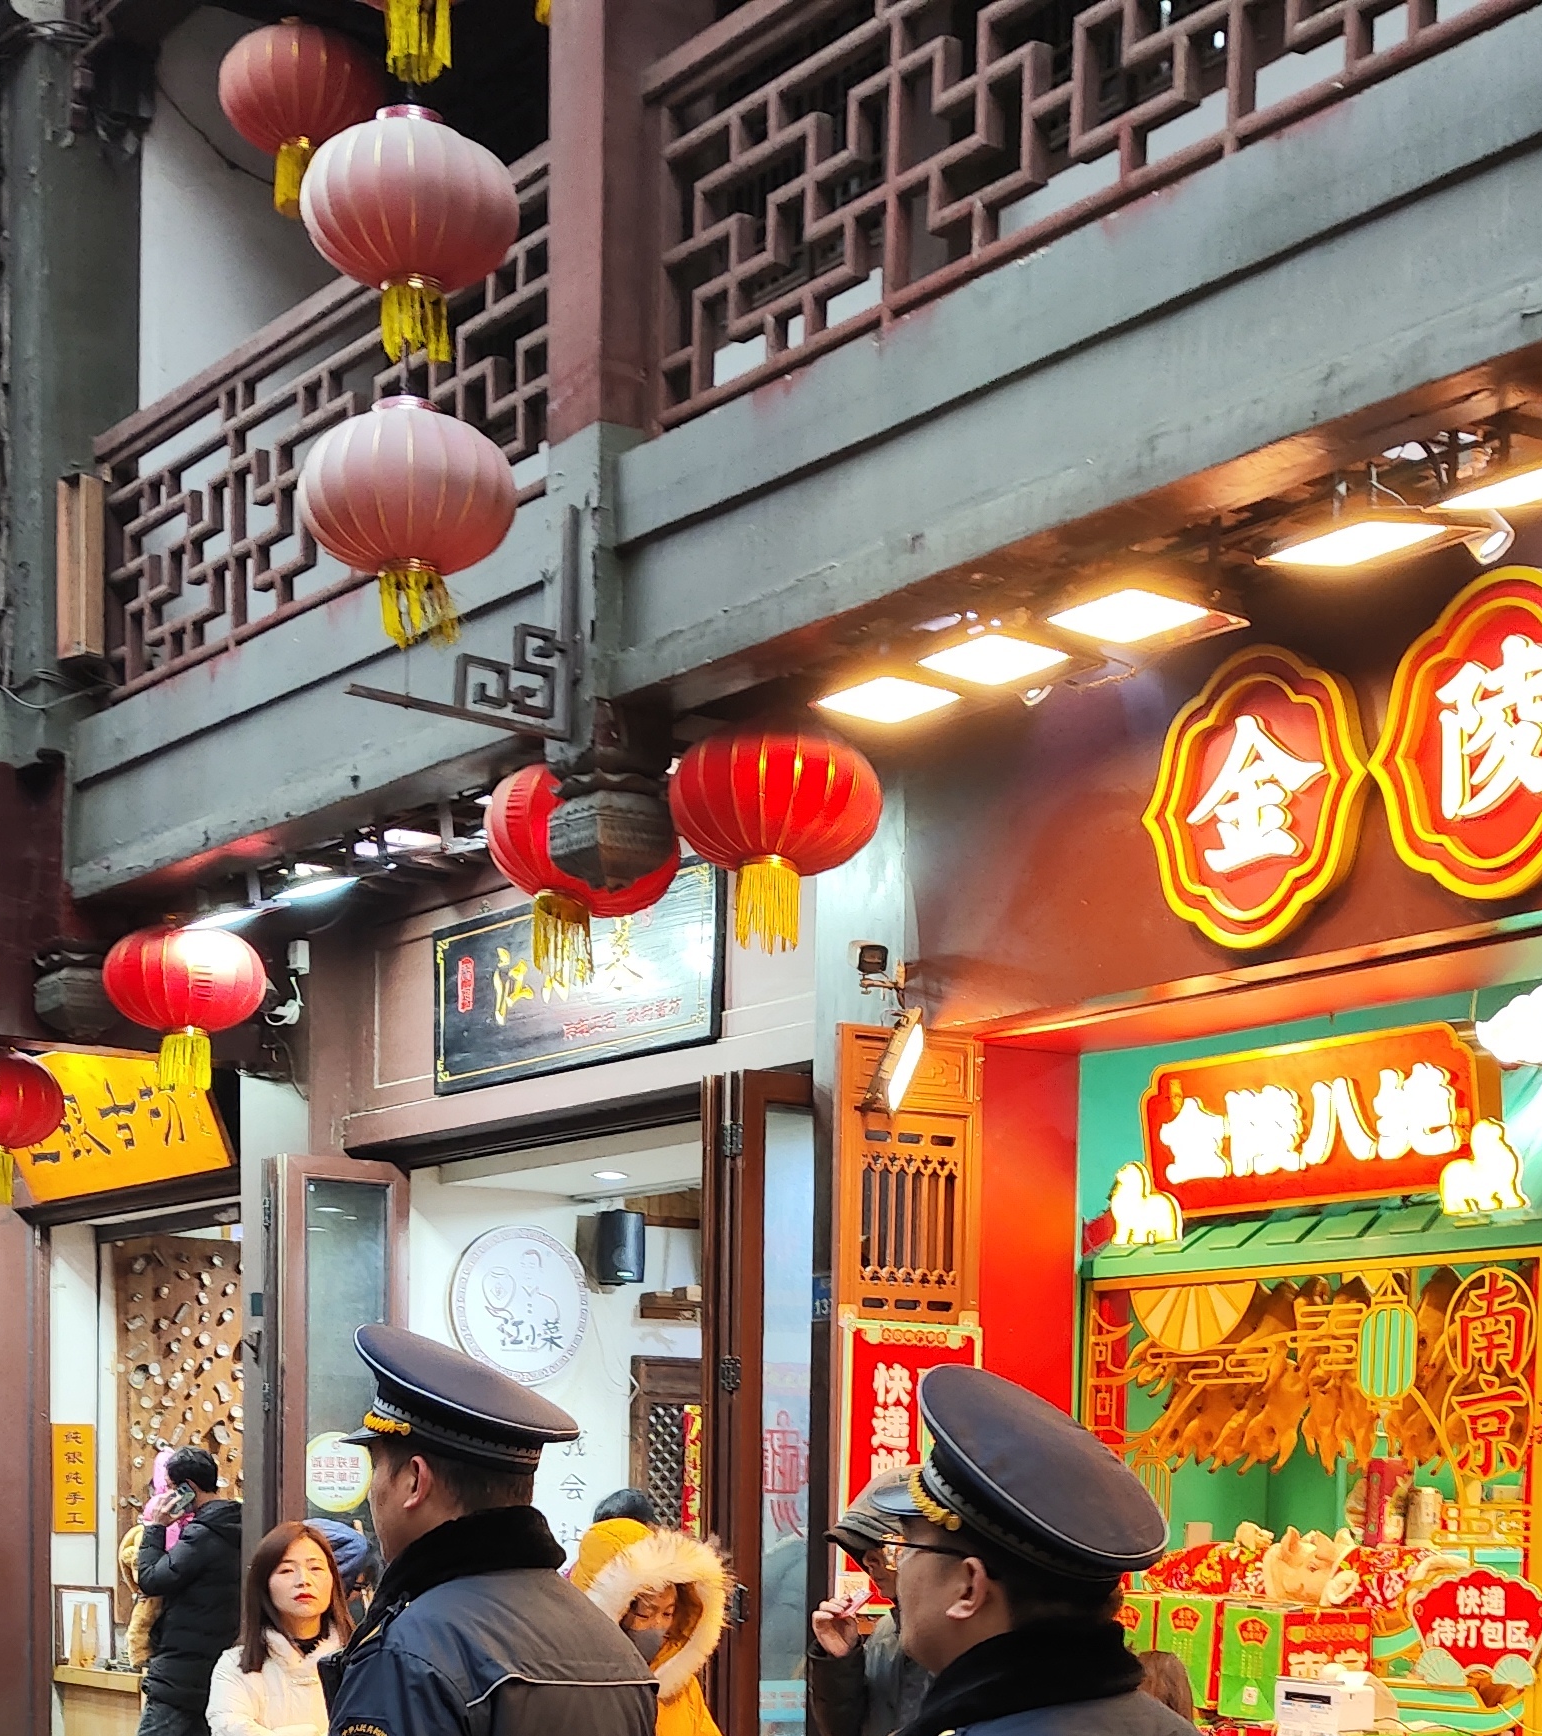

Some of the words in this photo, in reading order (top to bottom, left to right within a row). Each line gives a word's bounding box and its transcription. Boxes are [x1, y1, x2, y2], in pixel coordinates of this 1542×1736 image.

[1452, 1271, 1531, 1479] 南京
[1455, 1585, 1506, 1617] 快递
[1431, 1616, 1530, 1651] 待打包区
